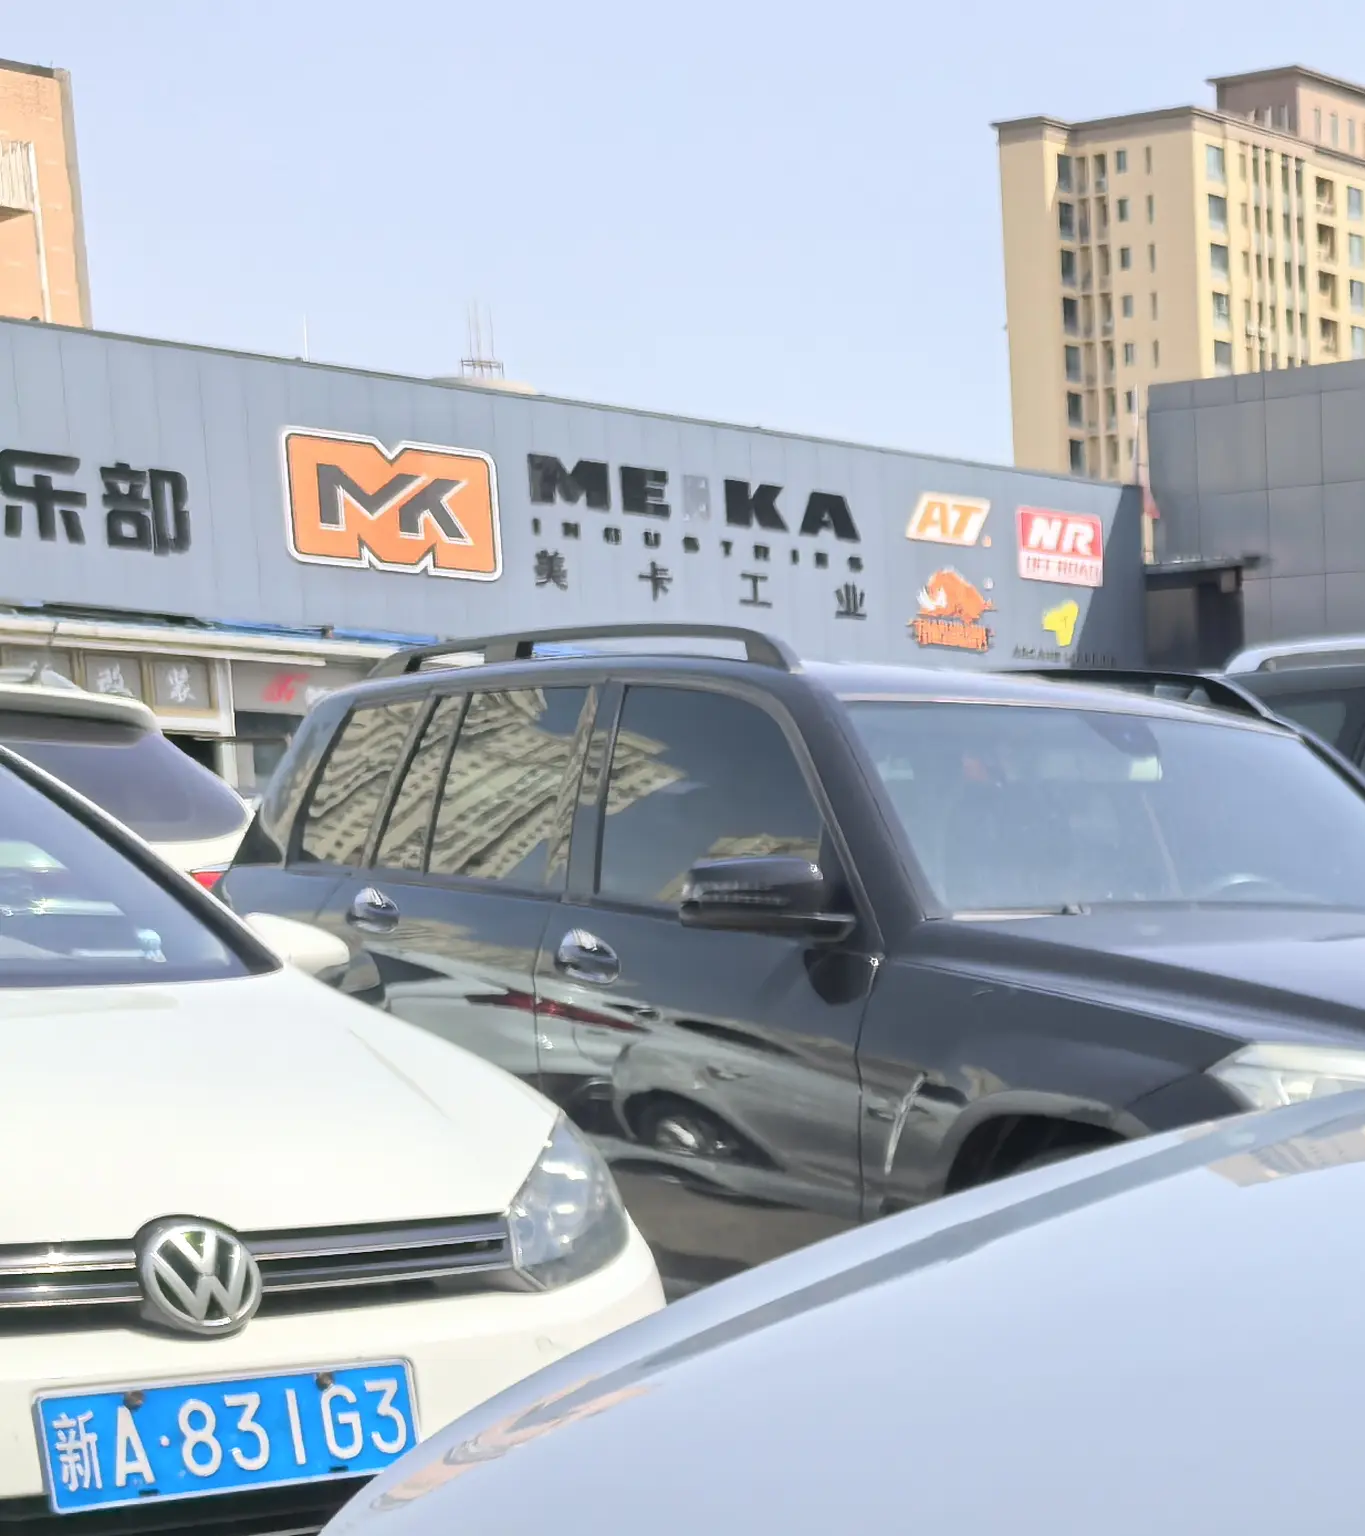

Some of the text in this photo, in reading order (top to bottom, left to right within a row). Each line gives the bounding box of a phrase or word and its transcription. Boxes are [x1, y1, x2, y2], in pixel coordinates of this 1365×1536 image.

[915, 500, 983, 540] AT
[1028, 515, 1095, 556] NR
[534, 549, 867, 620] 美卡工业
